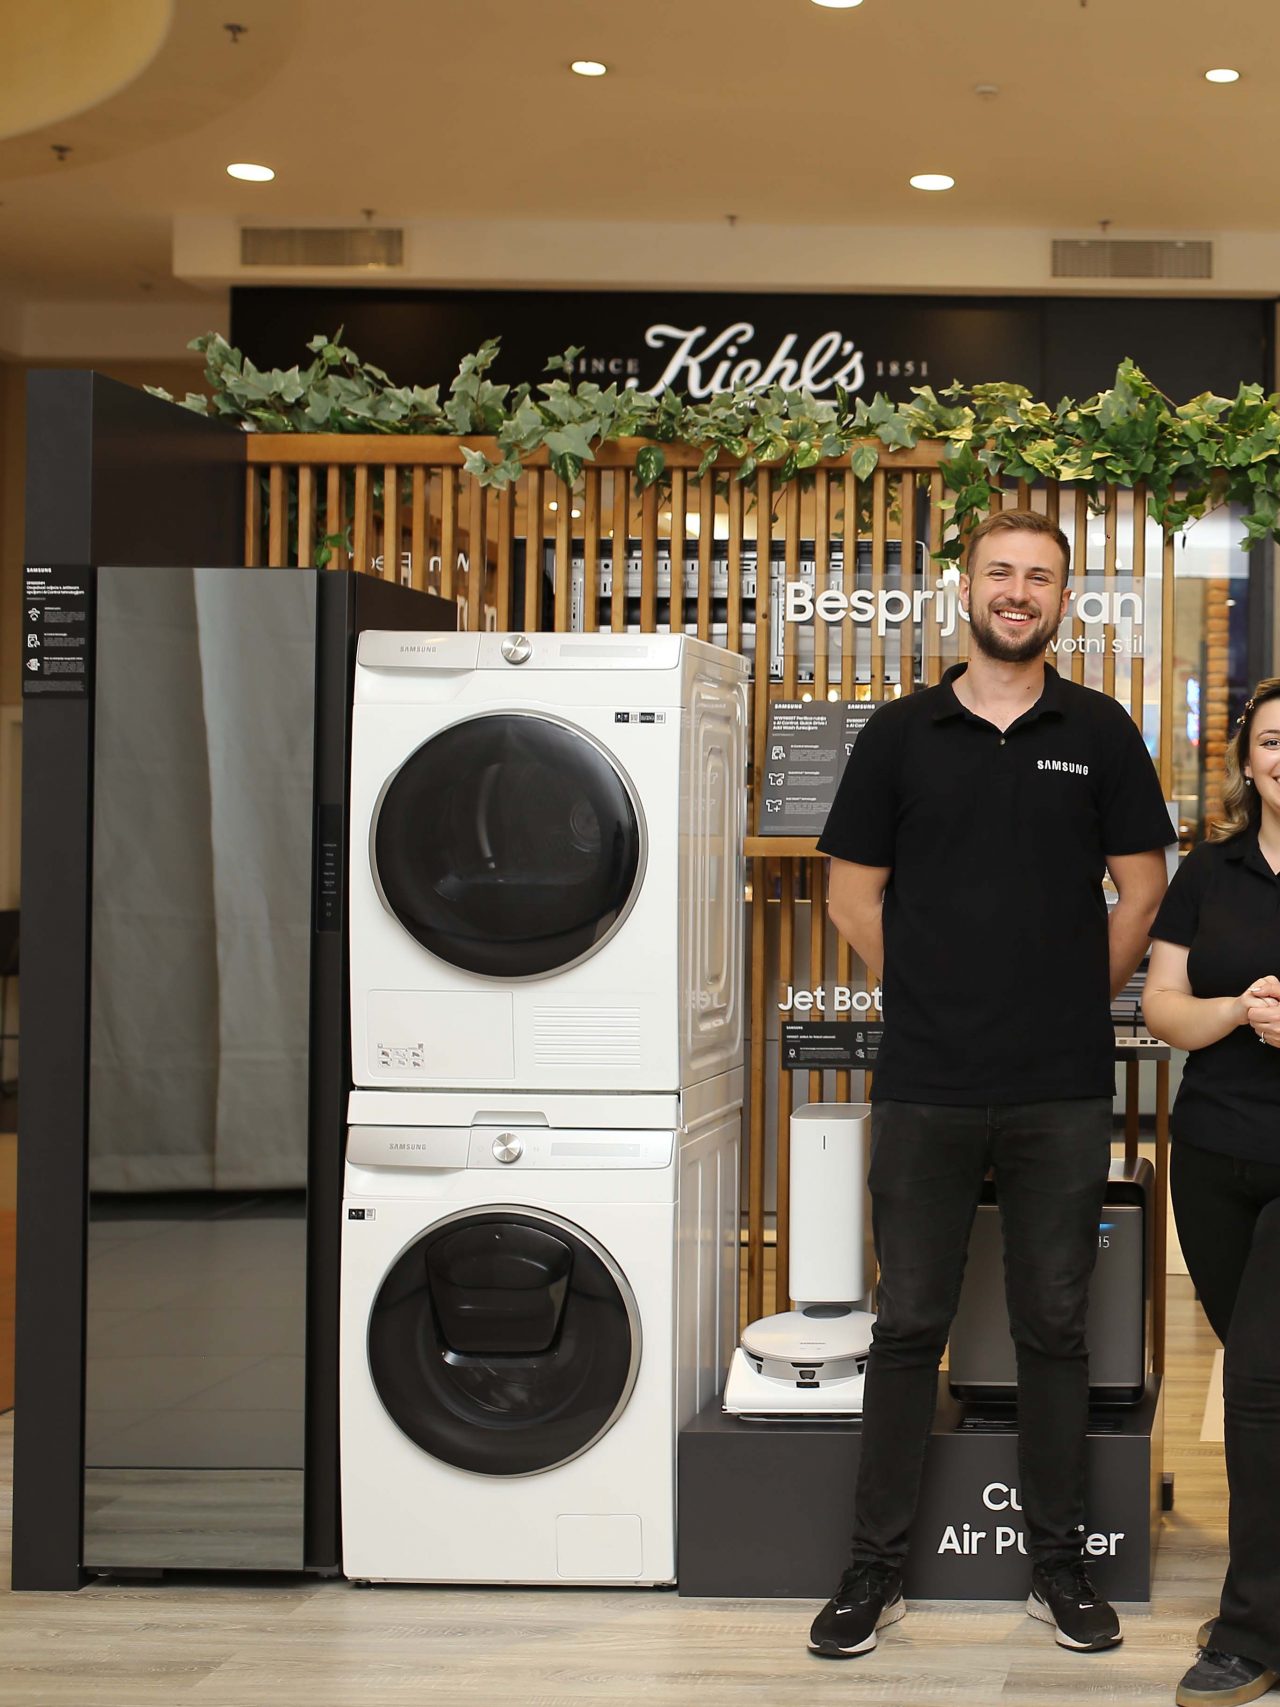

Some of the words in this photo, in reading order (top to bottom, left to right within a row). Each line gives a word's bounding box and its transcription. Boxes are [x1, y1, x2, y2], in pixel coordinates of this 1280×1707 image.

[625, 322, 865, 399] Kiehl's
[876, 361, 929, 377] 1851
[400, 645, 437, 653] SAMSUNG
[1037, 759, 1089, 776] SAMSUNG
[777, 985, 826, 1012] Jet
[833, 985, 883, 1012] Bot
[389, 1143, 427, 1151] SAMSUNG
[937, 1523, 987, 1556] Air
